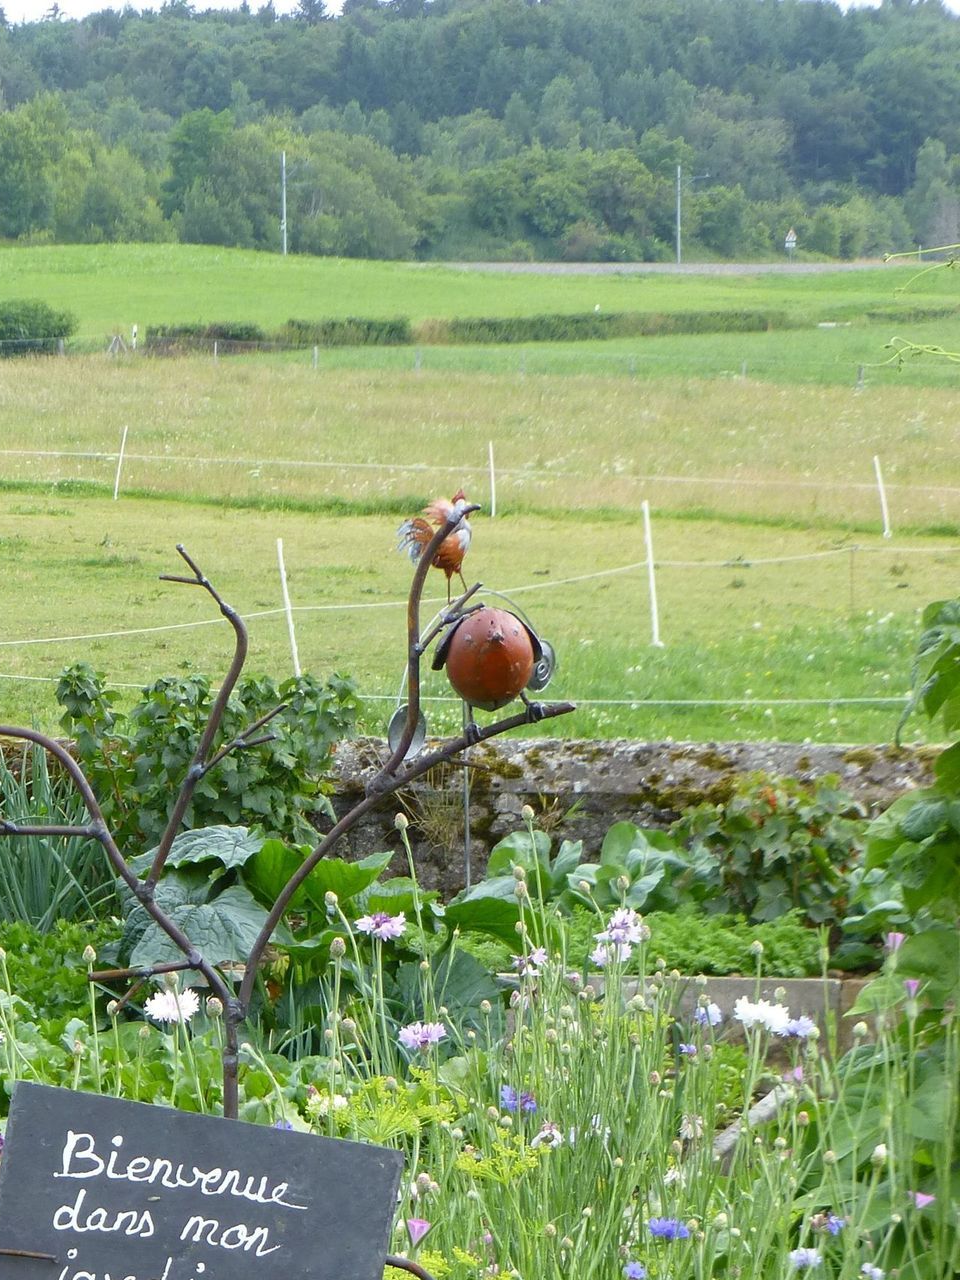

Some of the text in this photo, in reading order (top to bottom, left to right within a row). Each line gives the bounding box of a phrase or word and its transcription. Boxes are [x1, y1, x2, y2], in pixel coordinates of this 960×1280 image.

[53, 1130, 308, 1210] Bienvenue
[53, 1189, 281, 1257] dans mon
